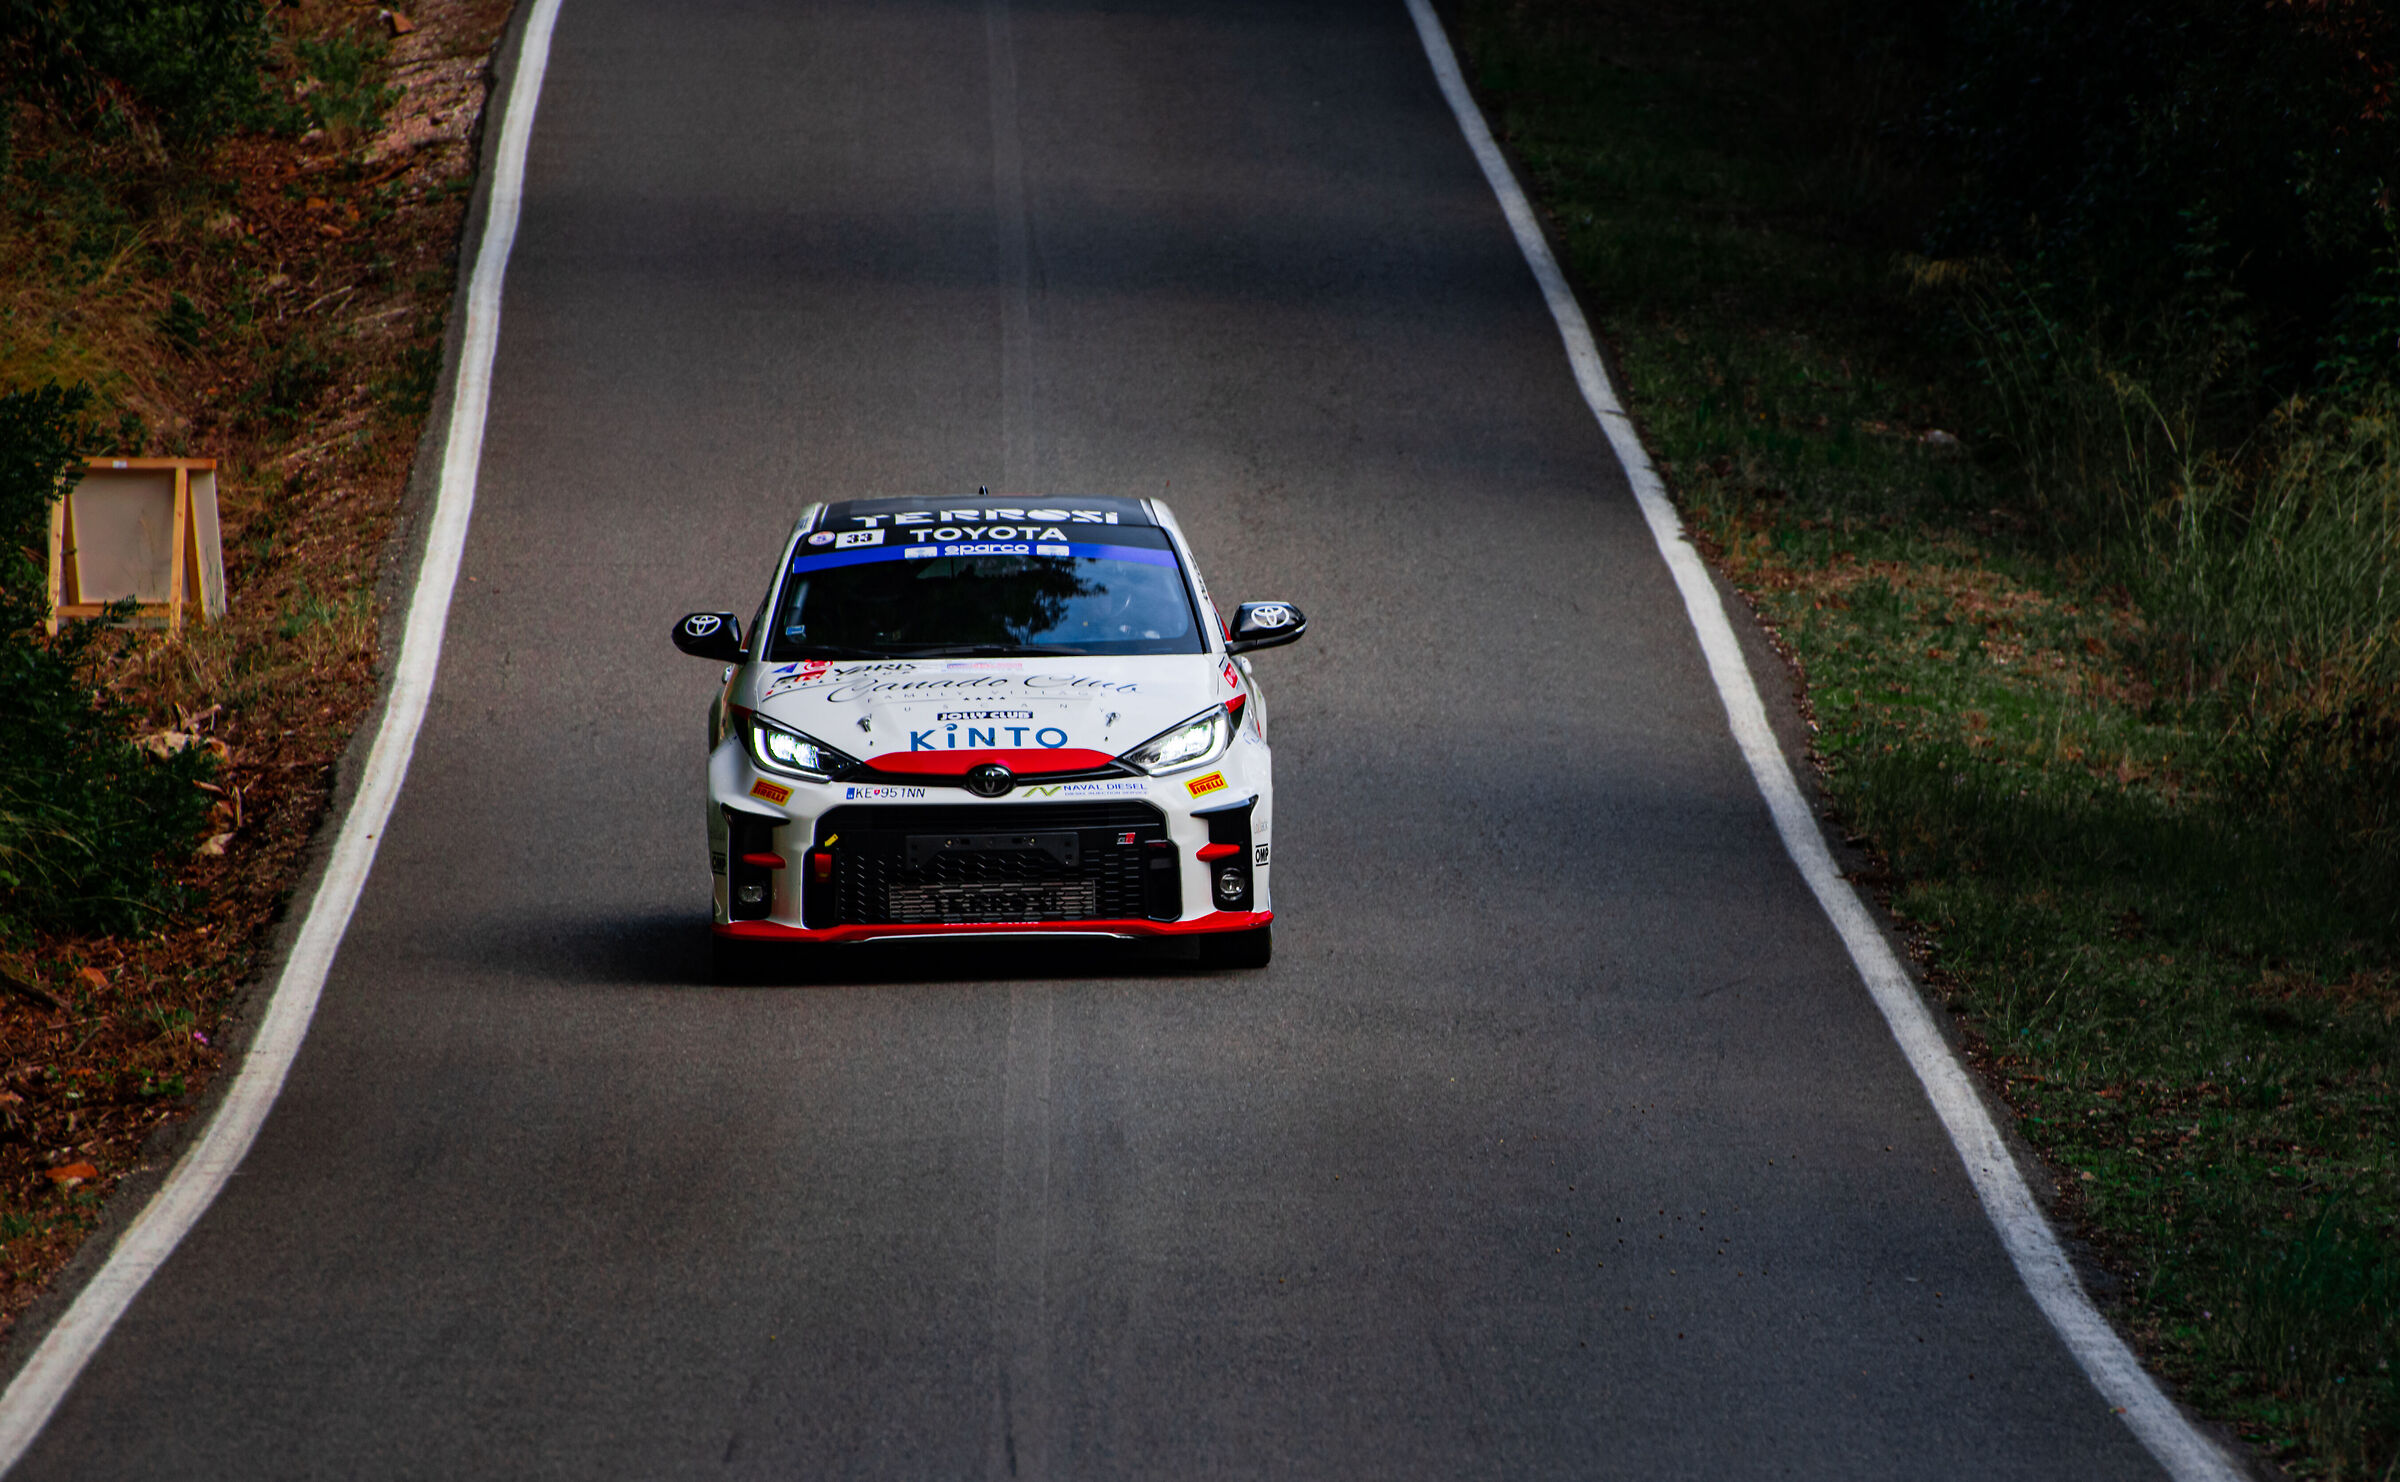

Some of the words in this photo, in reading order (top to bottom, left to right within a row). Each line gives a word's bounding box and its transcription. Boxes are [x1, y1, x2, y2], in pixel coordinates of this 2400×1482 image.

[851, 508, 1118, 528] TERROSI
[846, 532, 873, 544] 33
[909, 526, 1068, 543] TOYOTA
[944, 544, 1030, 557] sparco
[940, 712, 987, 721] JOLLY
[989, 711, 1031, 720] CLUB
[752, 781, 789, 803] PIRELLI
[855, 787, 872, 799] KE
[1188, 774, 1224, 795] PIRELLI
[1255, 846, 1269, 863] OMP
